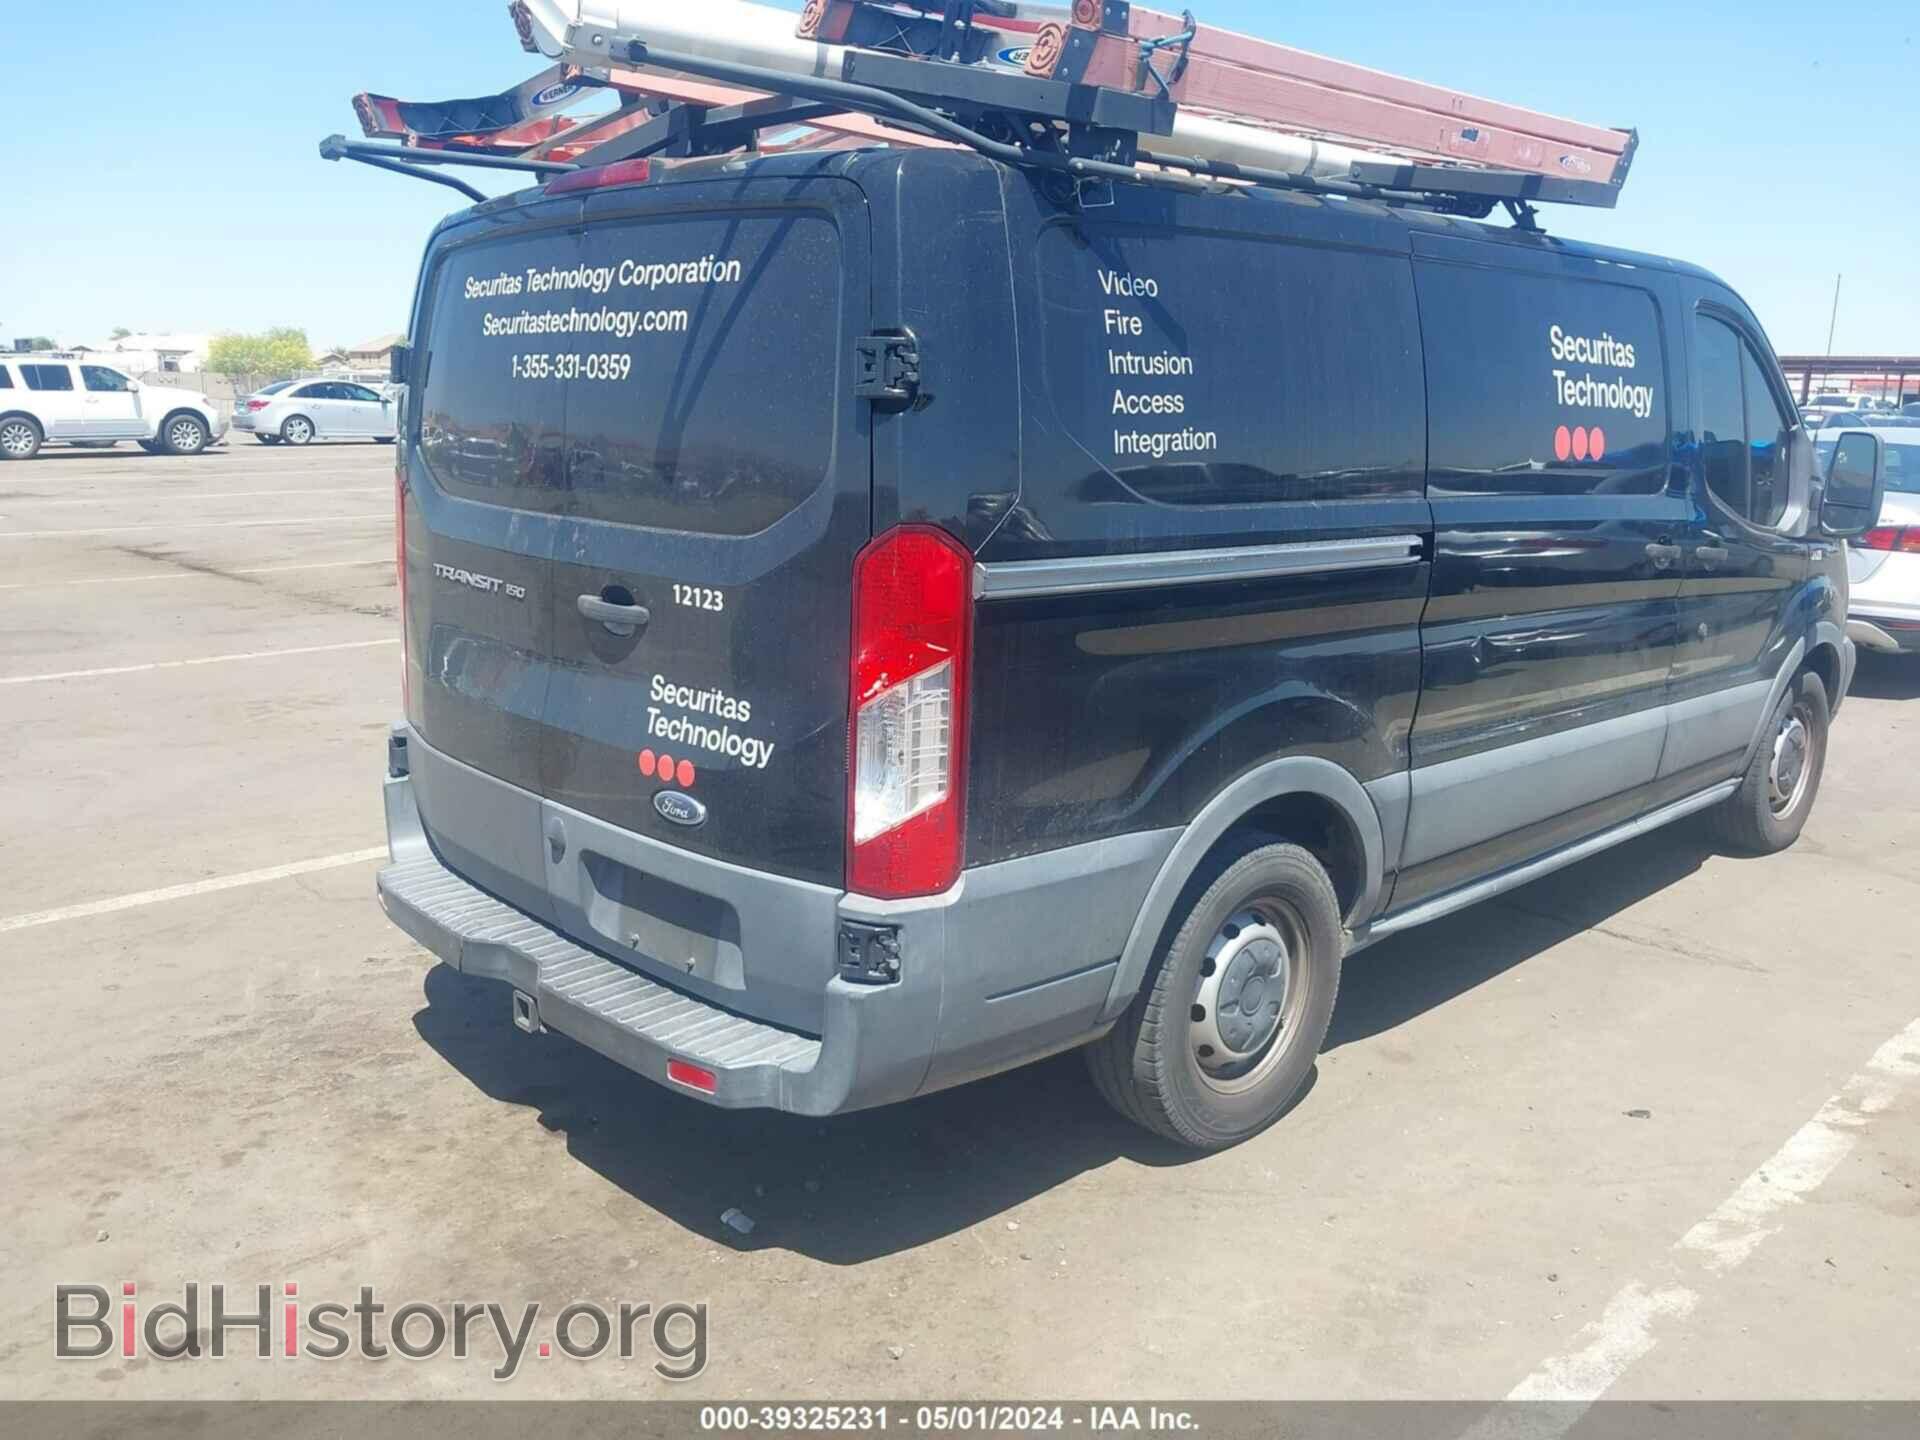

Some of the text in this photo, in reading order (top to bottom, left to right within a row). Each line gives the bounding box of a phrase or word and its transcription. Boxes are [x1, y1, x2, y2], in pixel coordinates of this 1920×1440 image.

[465, 254, 741, 298] Securitas Technology Corporation
[1098, 270, 1158, 297] Video
[483, 306, 688, 337] Securitastechnology.com
[1104, 309, 1143, 336] Fire
[1550, 325, 1635, 368] Securitas
[511, 354, 631, 379] 1-355-331-0359
[1108, 349, 1193, 375] Intrusion
[1112, 389, 1185, 414] Access
[1552, 369, 1654, 418] Technology
[1114, 427, 1217, 458] Integration
[433, 563, 504, 592] TRANSIT
[673, 584, 724, 611] 12123
[650, 674, 751, 722] Securitas
[647, 707, 775, 769] Technology
[662, 797, 689, 819] Ford
